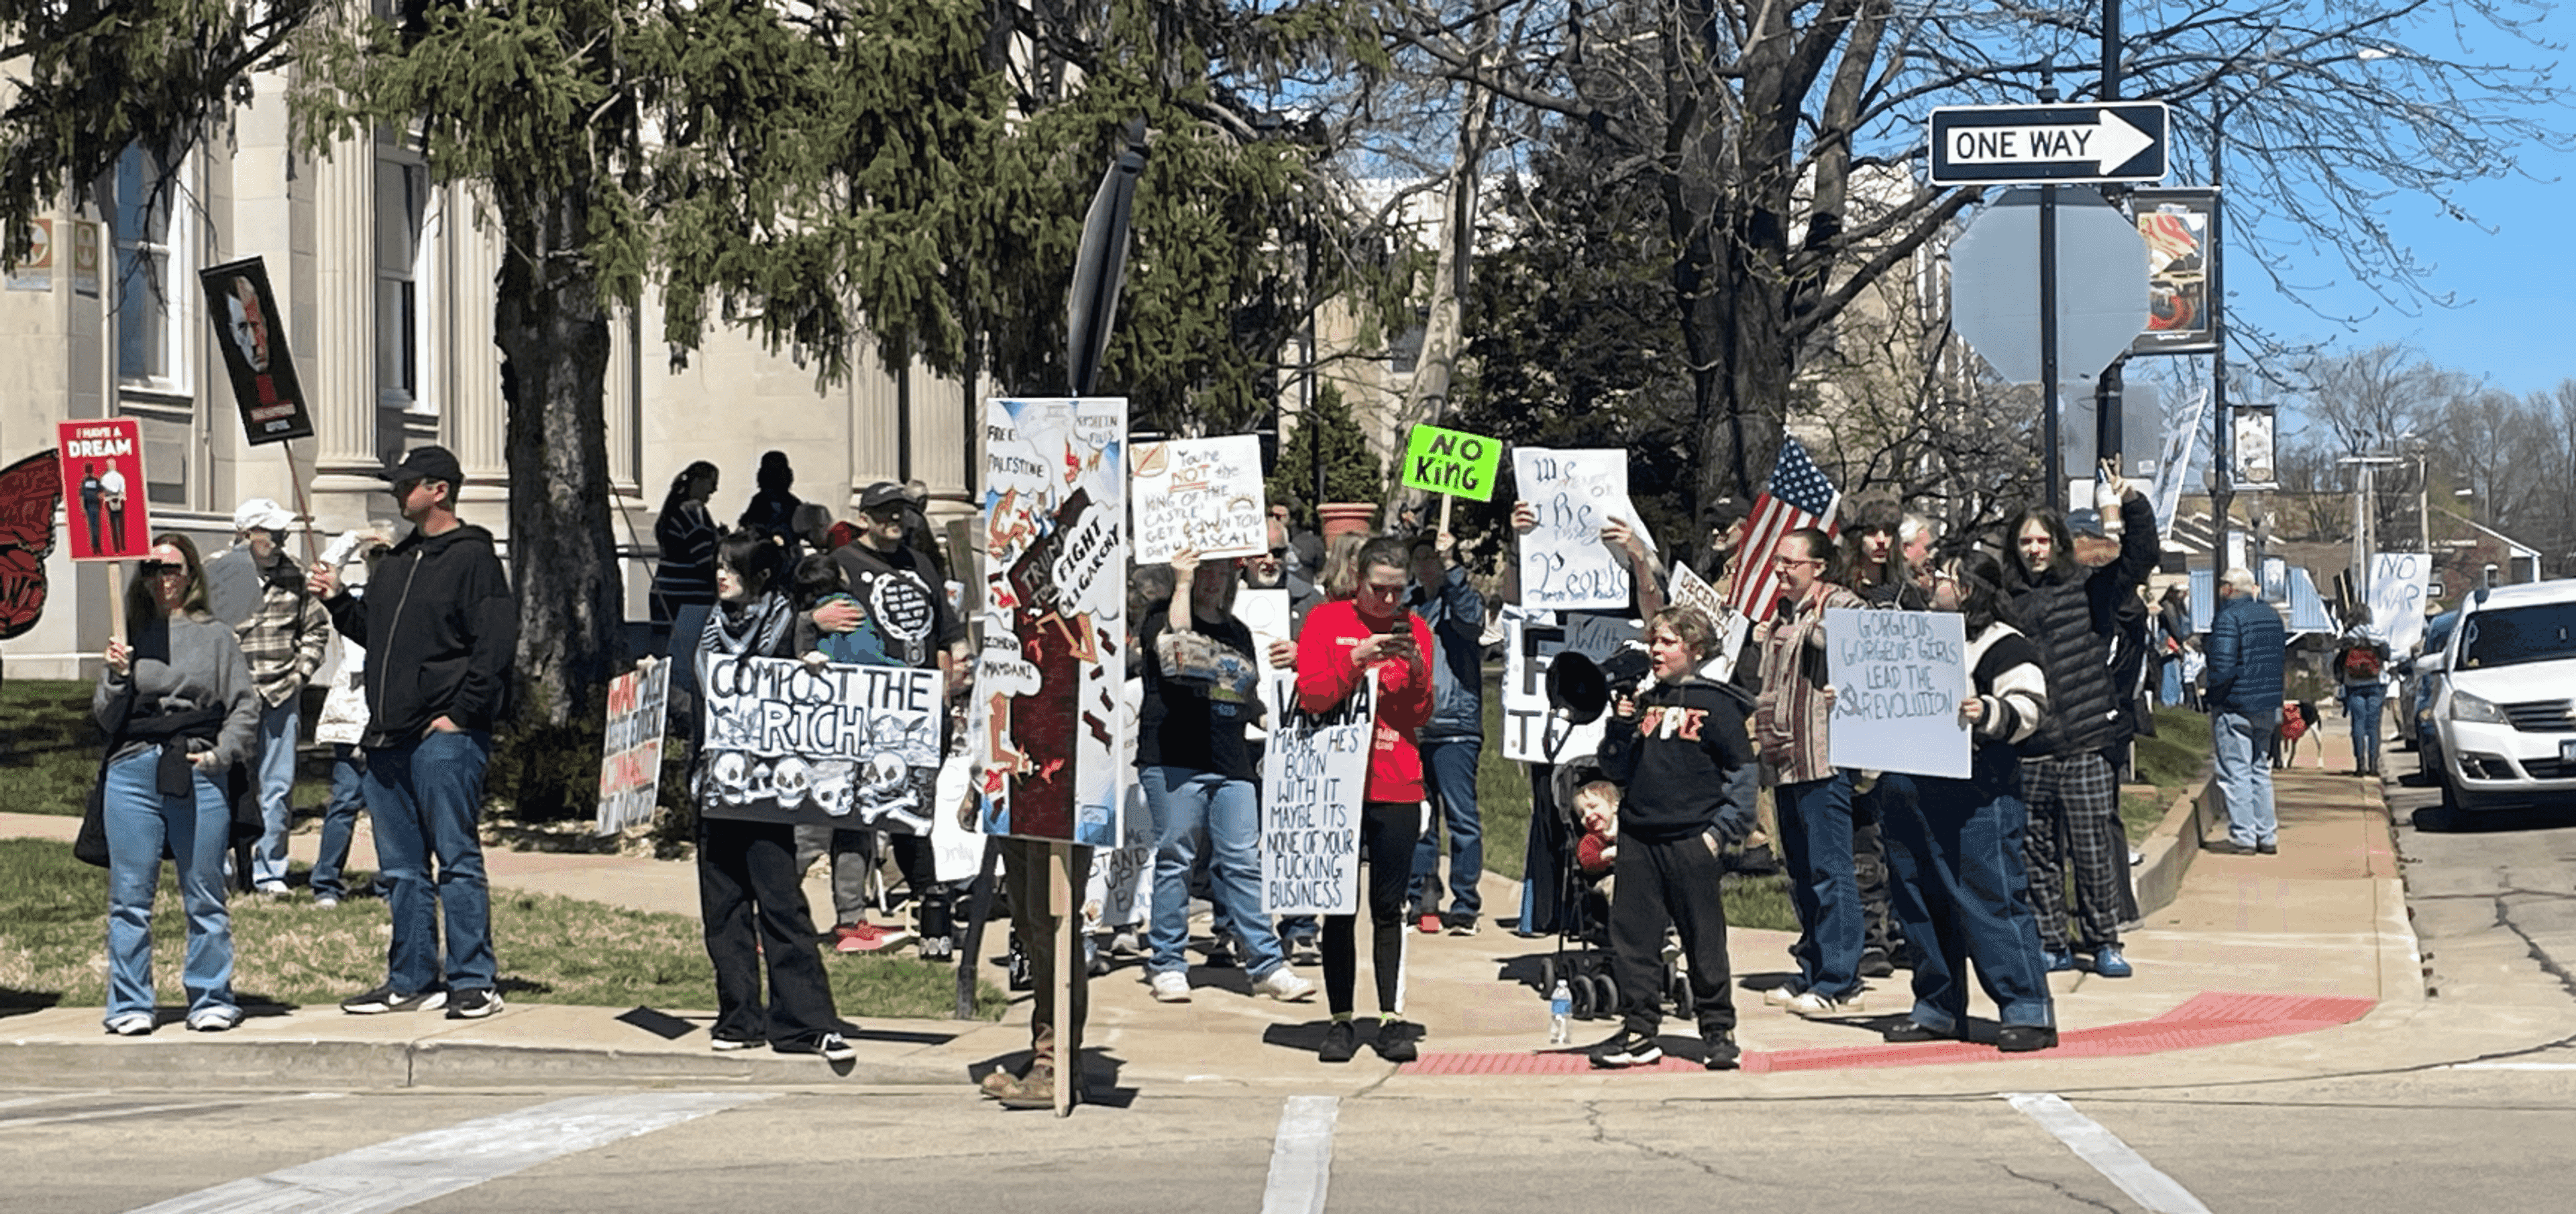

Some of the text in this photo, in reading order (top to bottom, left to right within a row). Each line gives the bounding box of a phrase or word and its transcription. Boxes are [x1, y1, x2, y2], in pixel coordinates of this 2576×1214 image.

[1956, 129, 2093, 159] ONE WAY
[76, 428, 82, 438] I
[113, 425, 123, 438] A
[987, 425, 1016, 442] FREE
[67, 438, 132, 458] DREAM
[1428, 434, 1483, 462] NO
[987, 453, 1044, 478] PALESTINE
[1171, 464, 1211, 484] NOT
[1145, 527, 1175, 544] GET
[1234, 514, 1263, 529] YOU
[1058, 514, 1102, 583] FIGHT
[2377, 554, 2417, 580] NO
[2376, 583, 2420, 611] WAR
[1857, 611, 1935, 641] GORGEOUS
[1840, 638, 1960, 666] GORGEOUS GIRLS
[711, 658, 858, 705] COMPOST
[863, 668, 933, 713] THE
[1866, 664, 1935, 691] LEAD THE
[1861, 688, 1953, 722] REVOLUTION
[761, 699, 865, 758] RICH
[1285, 752, 1328, 779] BORN
[1277, 777, 1341, 804] WITH IT
[1270, 803, 1347, 829] MAYBE ITS
[1266, 828, 1354, 856] NONE OF YOUR
[1275, 851, 1343, 880] FUCKING
[1270, 878, 1342, 910] BUSINESS
